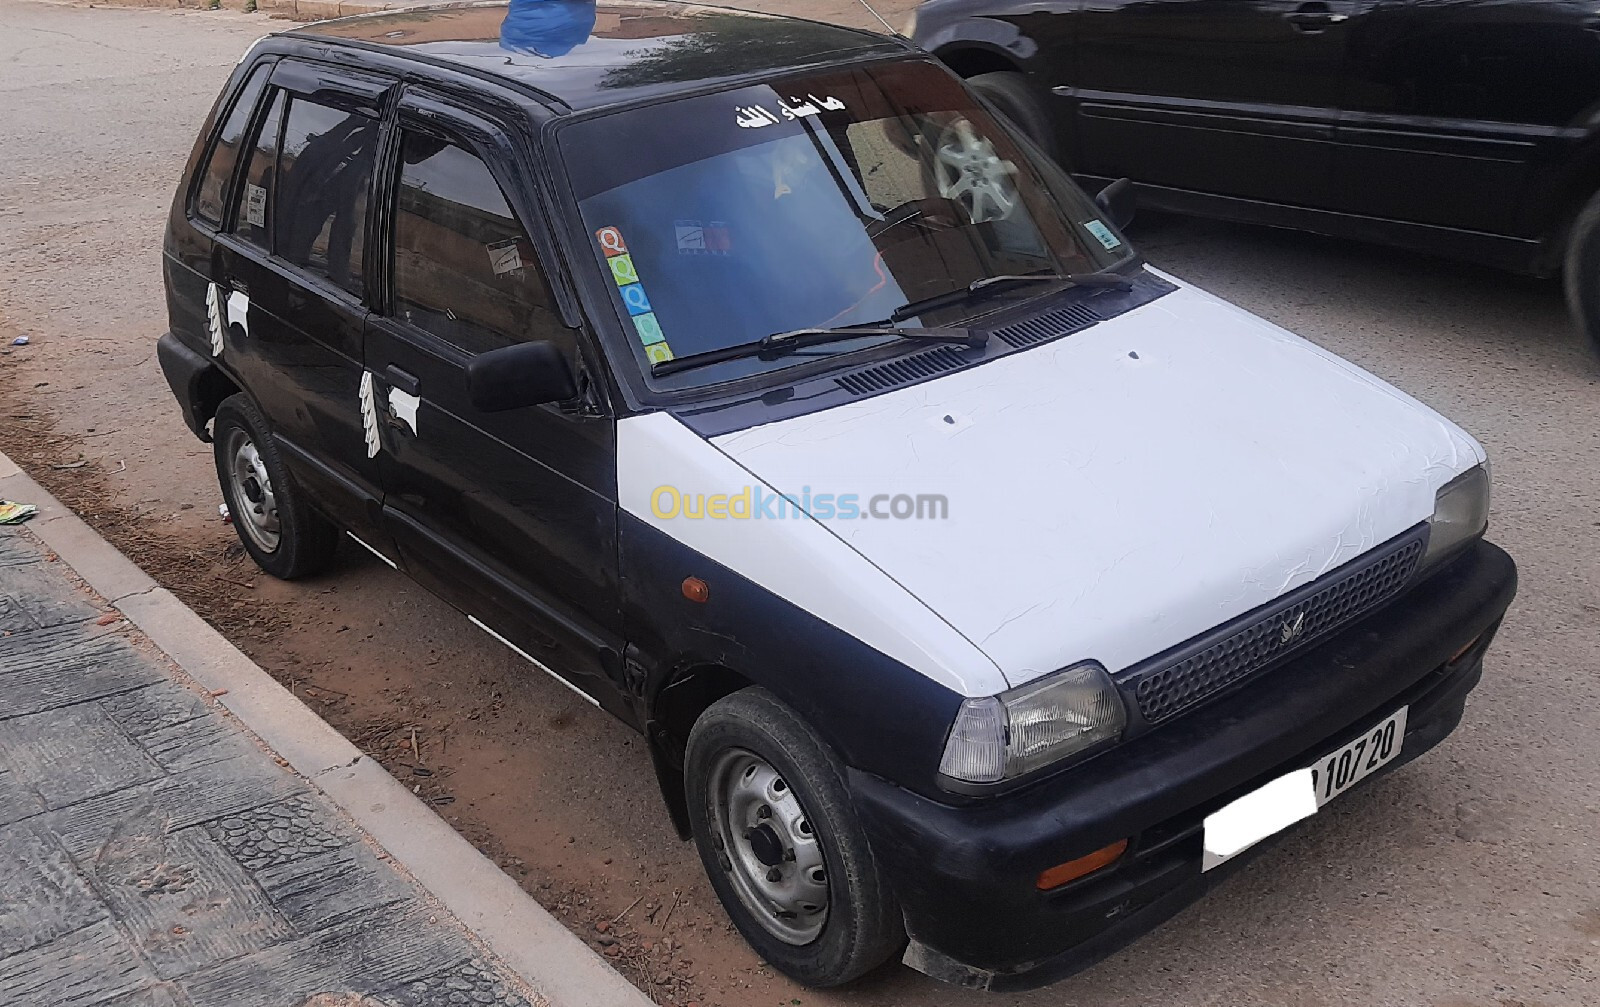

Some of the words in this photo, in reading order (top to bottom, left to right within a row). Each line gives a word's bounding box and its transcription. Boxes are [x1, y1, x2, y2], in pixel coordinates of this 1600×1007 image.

[807, 93, 846, 111] ما
[735, 104, 780, 128] الله
[600, 229, 626, 253] Q
[612, 255, 639, 282] Q
[624, 286, 651, 310] Q
[1325, 738, 1368, 798] 107
[1366, 720, 1395, 770] 20
